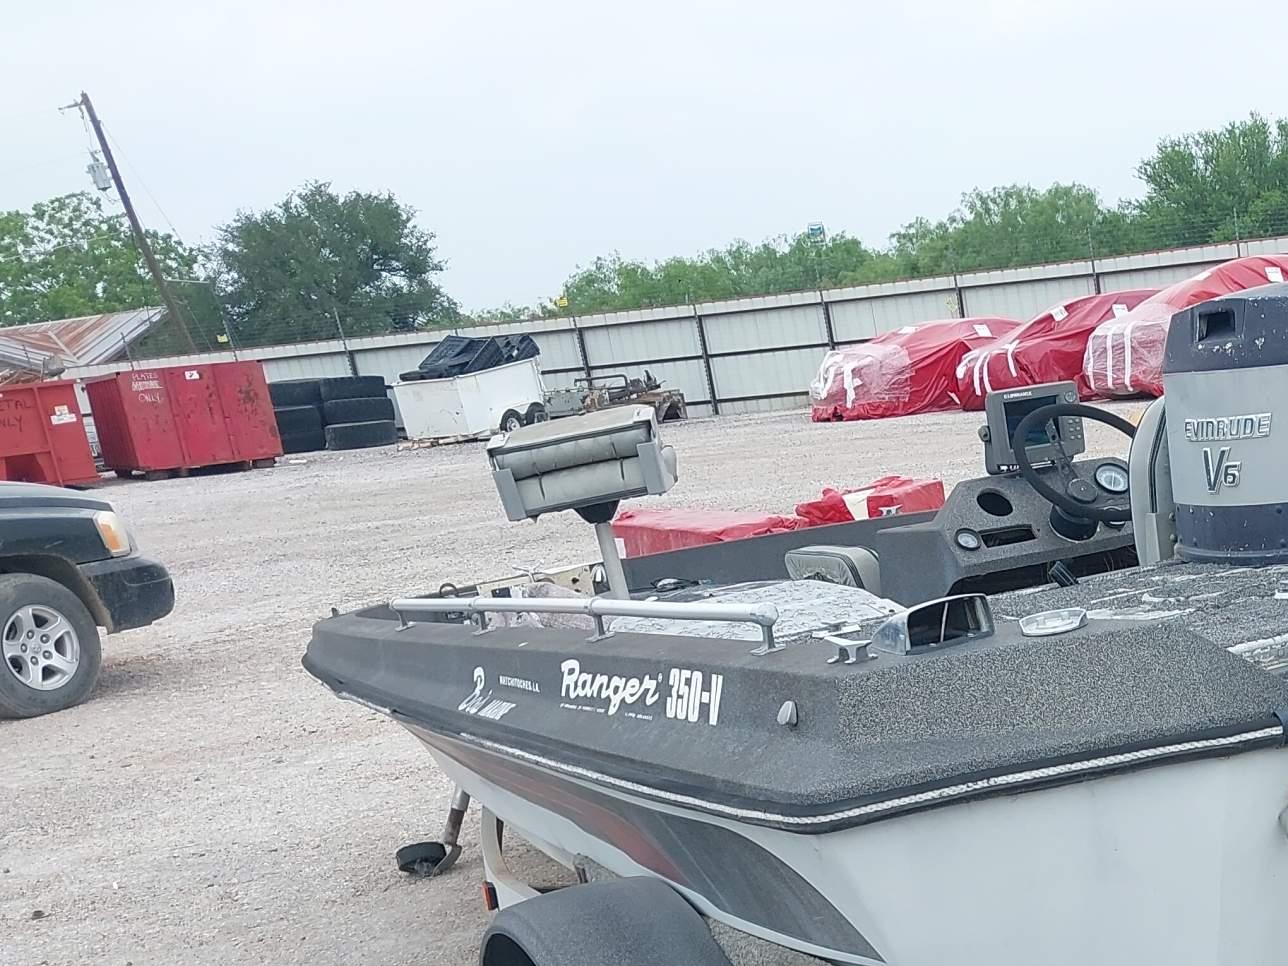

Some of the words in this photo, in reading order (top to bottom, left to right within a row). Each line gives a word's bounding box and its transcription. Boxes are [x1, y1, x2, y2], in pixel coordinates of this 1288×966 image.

[1184, 412, 1272, 442] EVINRUDE
[1202, 446, 1242, 495] V6
[560, 658, 660, 716] Ranger
[666, 667, 724, 726] 350-V
